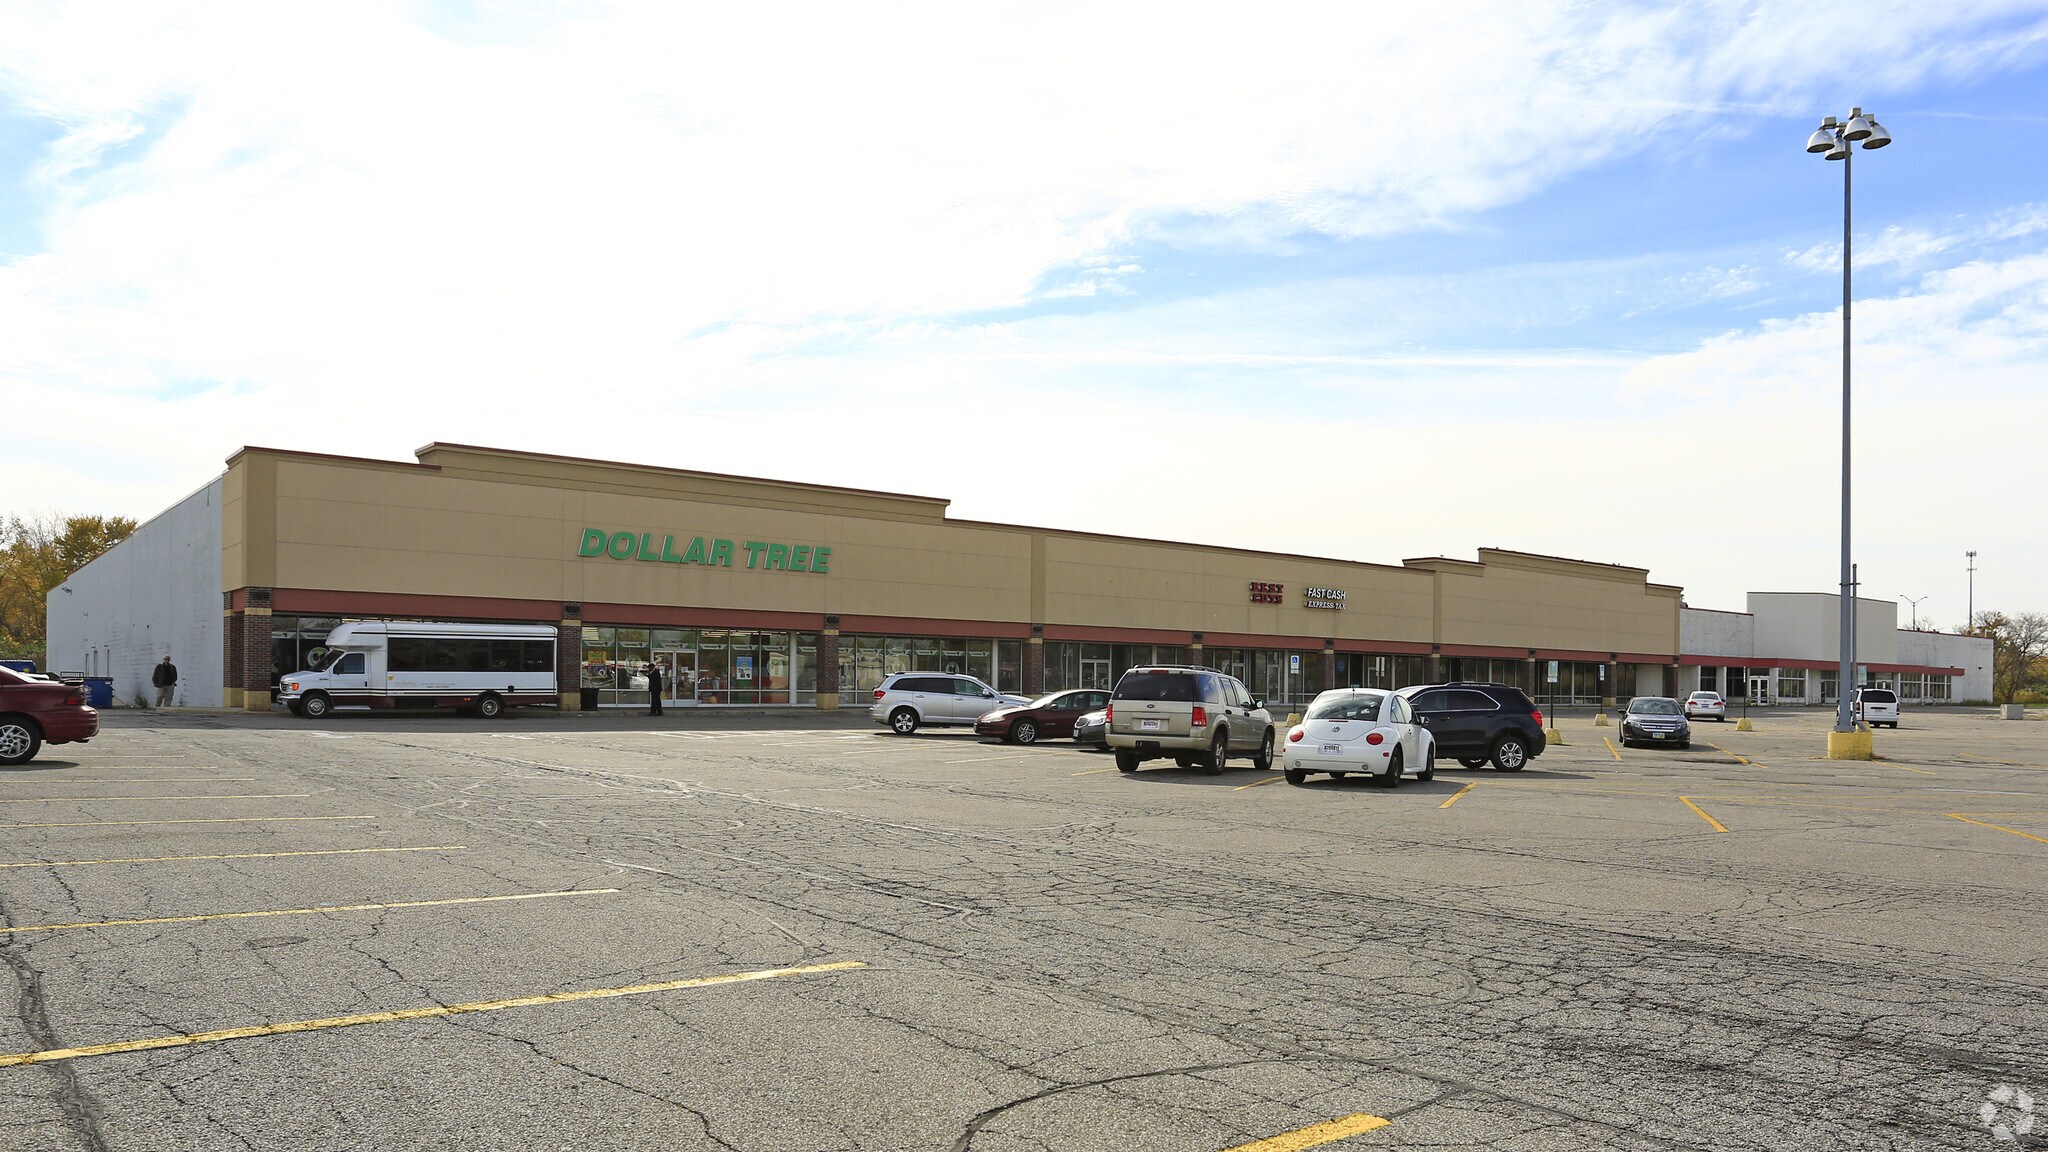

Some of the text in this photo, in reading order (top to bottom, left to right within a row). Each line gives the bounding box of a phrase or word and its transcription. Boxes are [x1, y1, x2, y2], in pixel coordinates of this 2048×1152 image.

[578, 528, 833, 573] DOLLAR TREE
[1250, 582, 1284, 593] BEST
[1306, 587, 1347, 600] FAST CASH
[1251, 593, 1284, 605] CUTS
[1307, 600, 1346, 610] EXPRESS TAX
